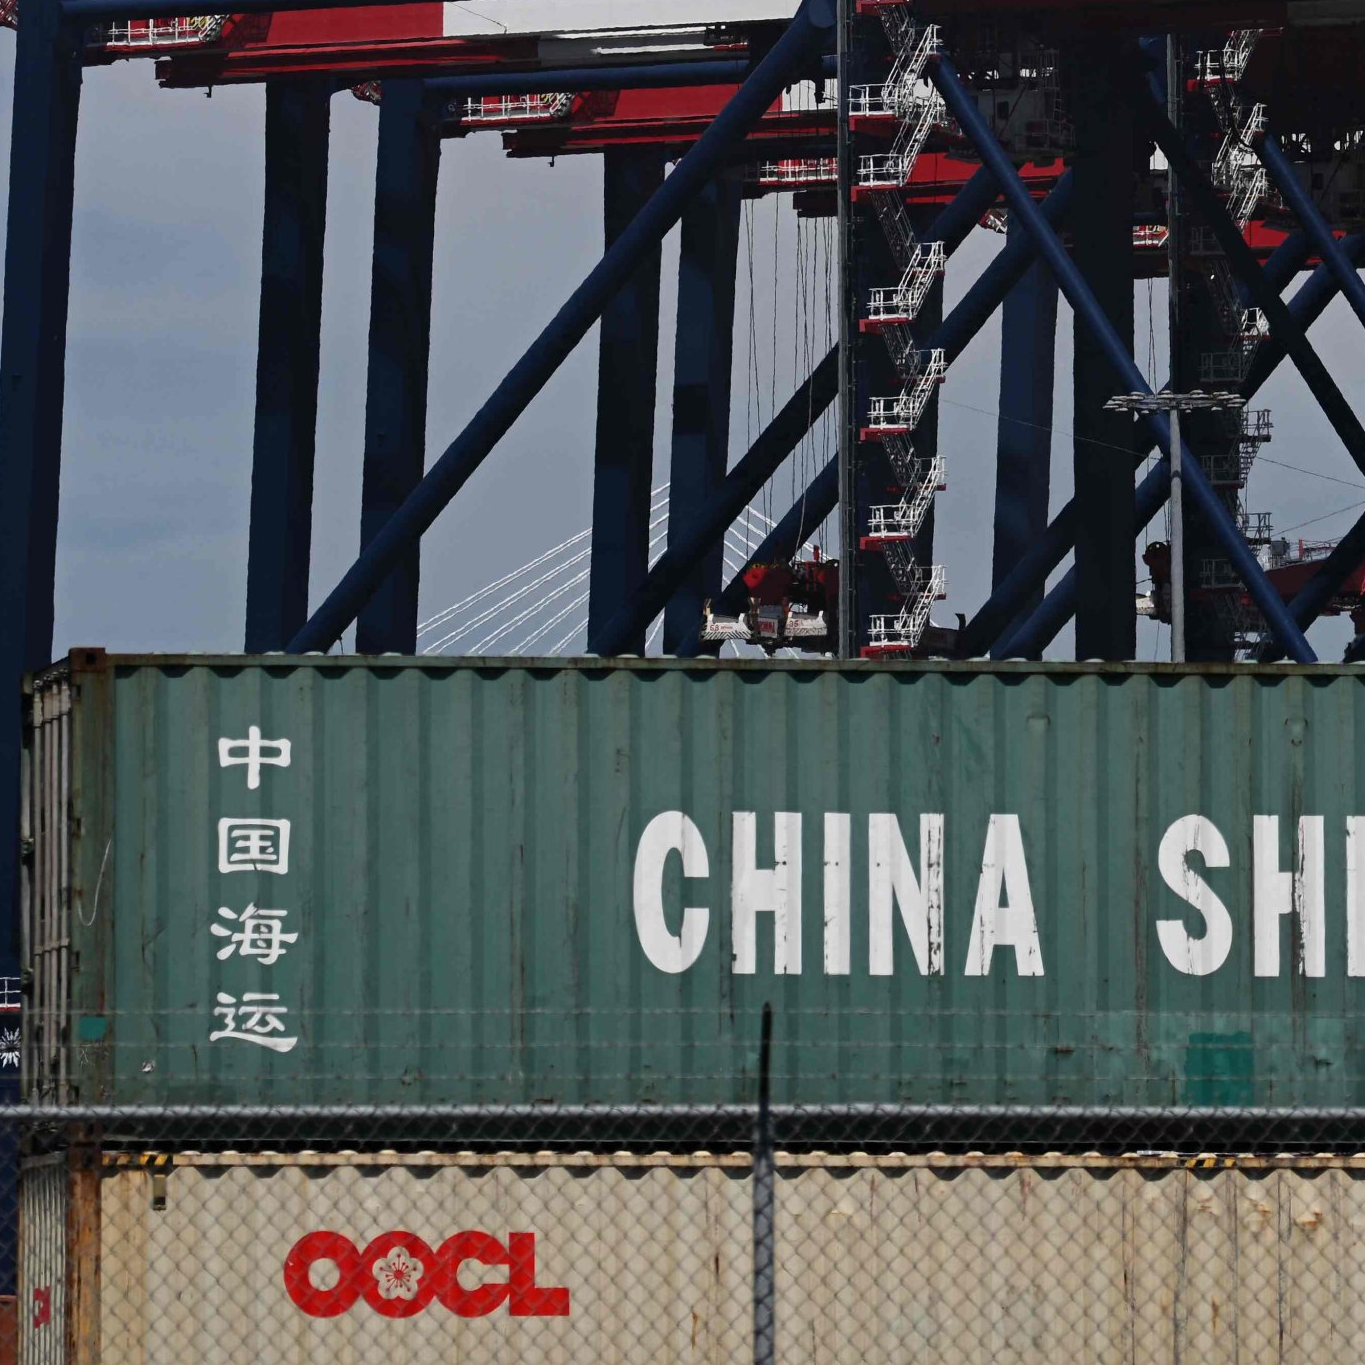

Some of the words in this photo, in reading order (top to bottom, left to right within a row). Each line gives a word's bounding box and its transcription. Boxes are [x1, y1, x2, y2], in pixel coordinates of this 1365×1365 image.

[209, 726, 299, 1053] 中国海运
[633, 811, 1045, 976] CHINA
[283, 1230, 571, 1319] OOCL
